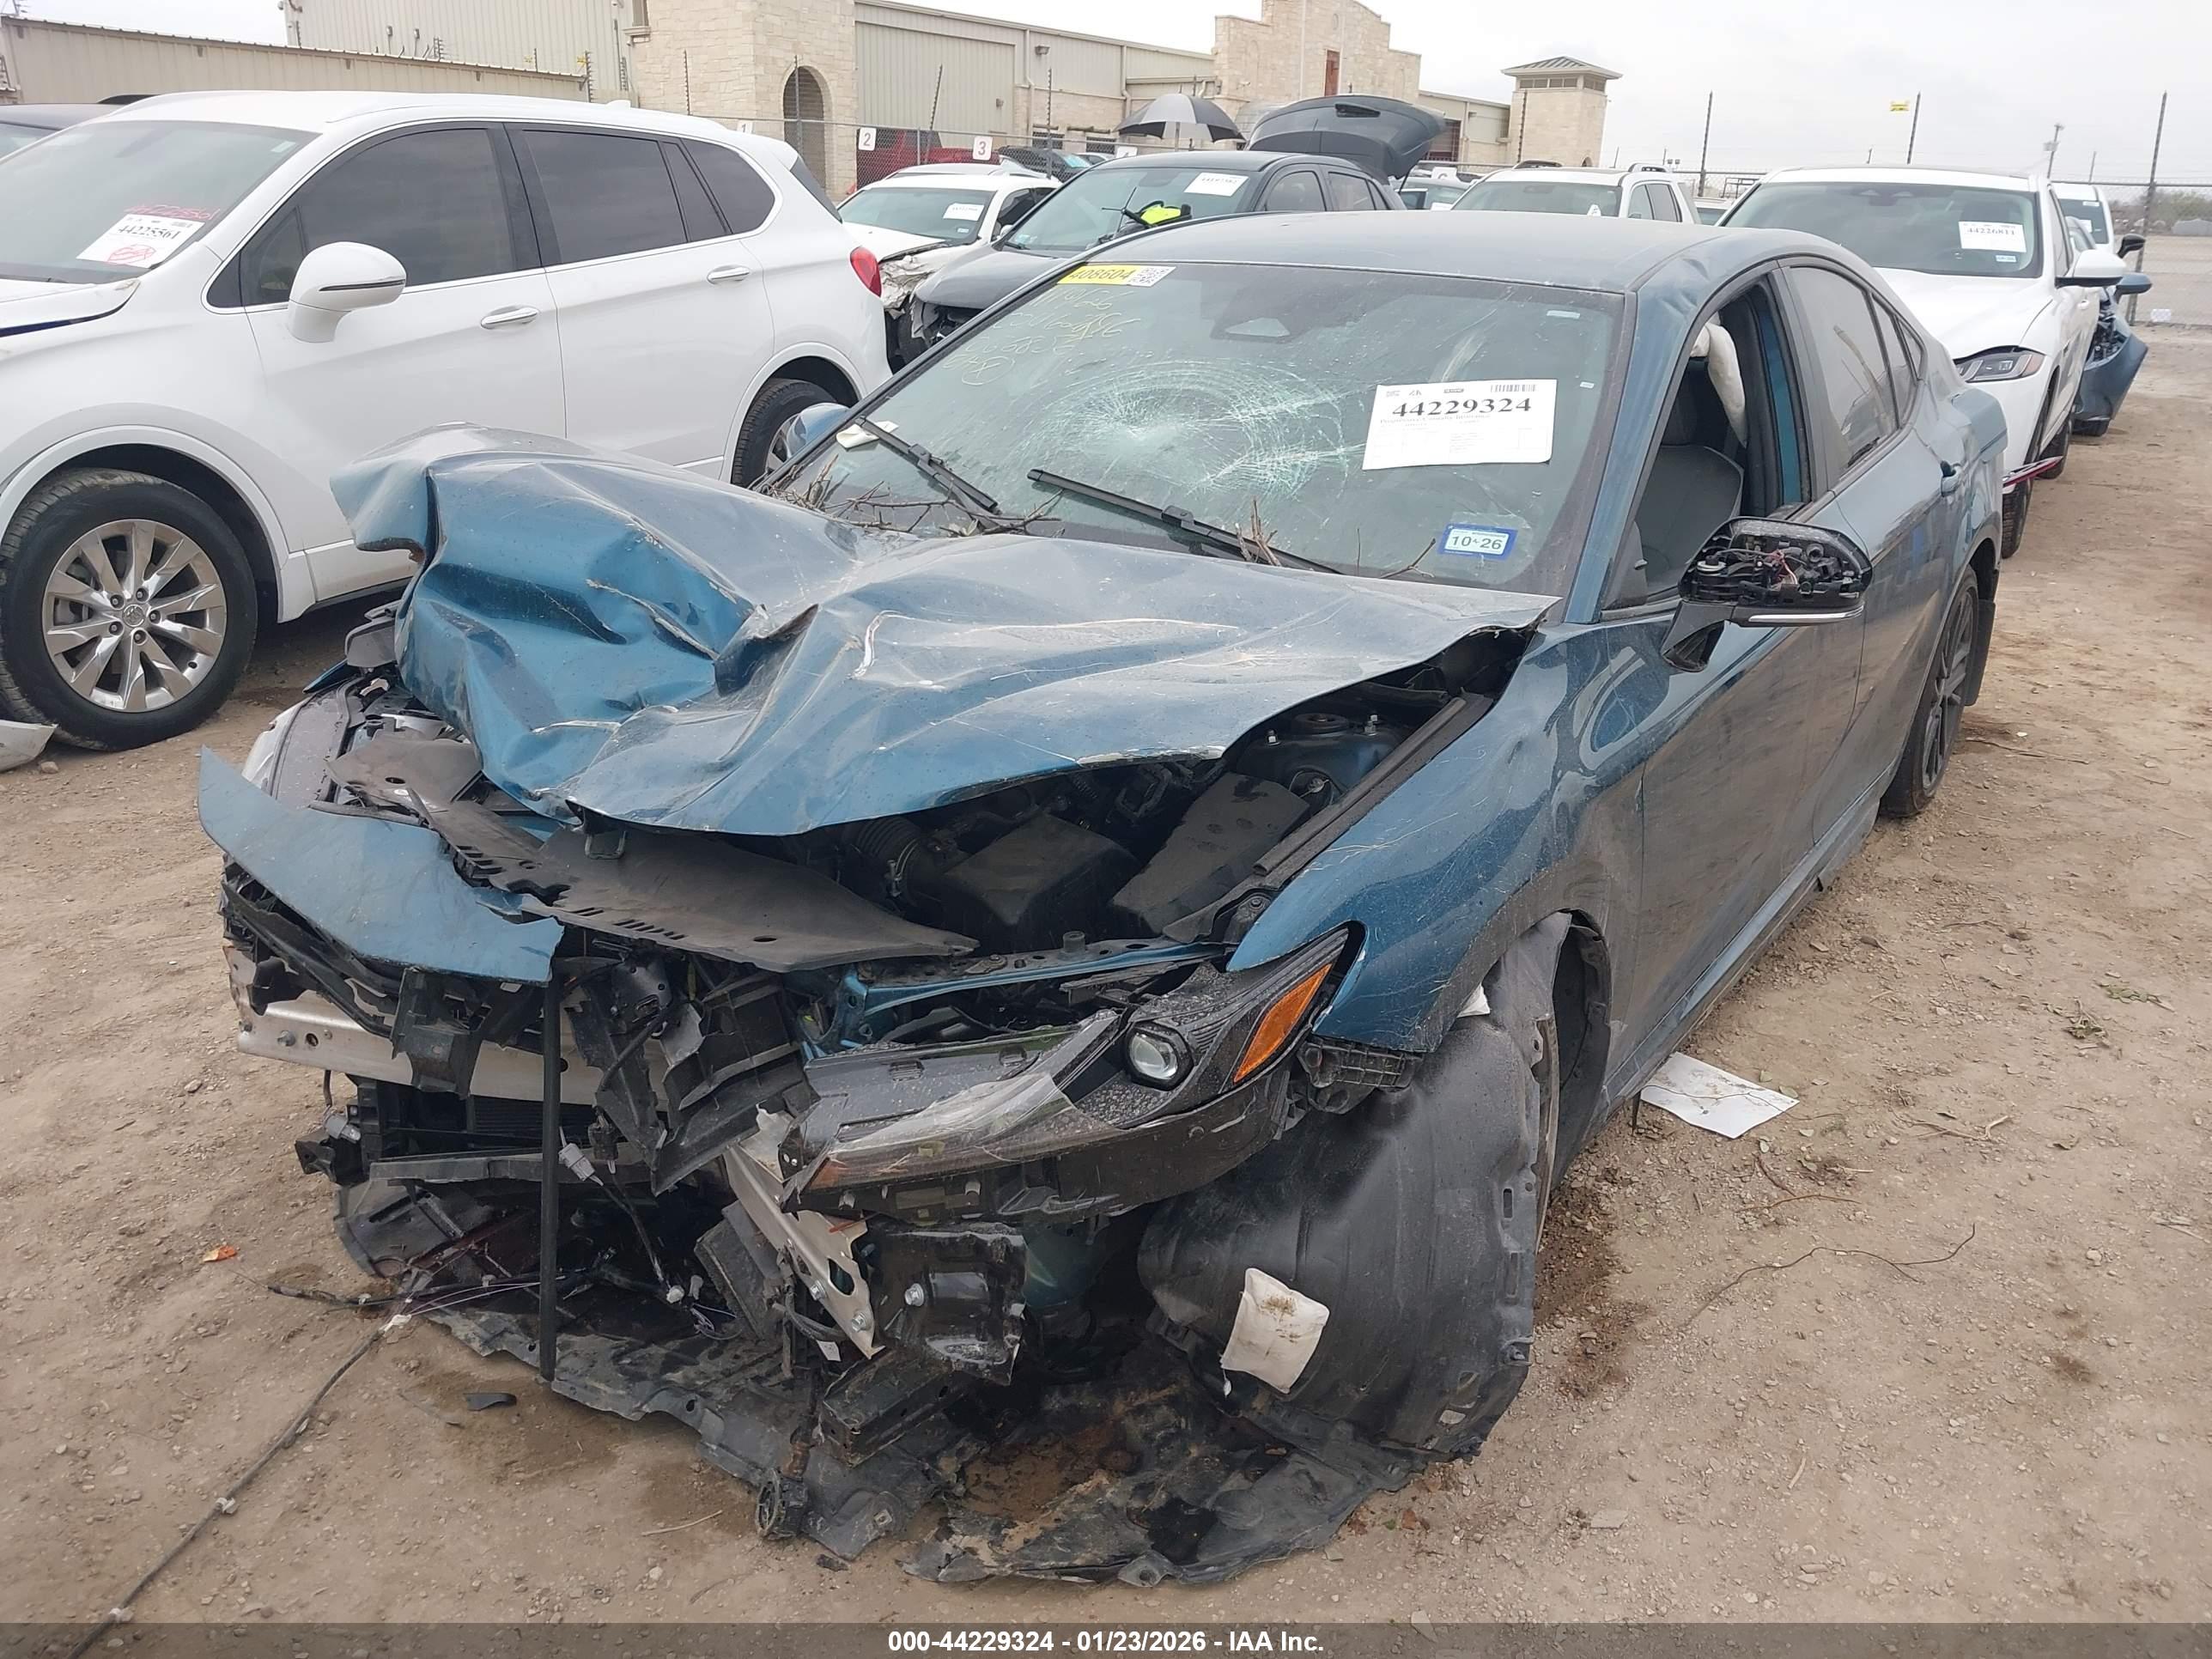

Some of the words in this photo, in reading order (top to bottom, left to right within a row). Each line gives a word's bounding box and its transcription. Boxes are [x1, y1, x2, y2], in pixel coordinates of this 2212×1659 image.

[862, 132, 872, 147] 2
[977, 141, 988, 155] 3
[1069, 269, 1137, 280] 408604
[1391, 398, 1533, 417] 44229324
